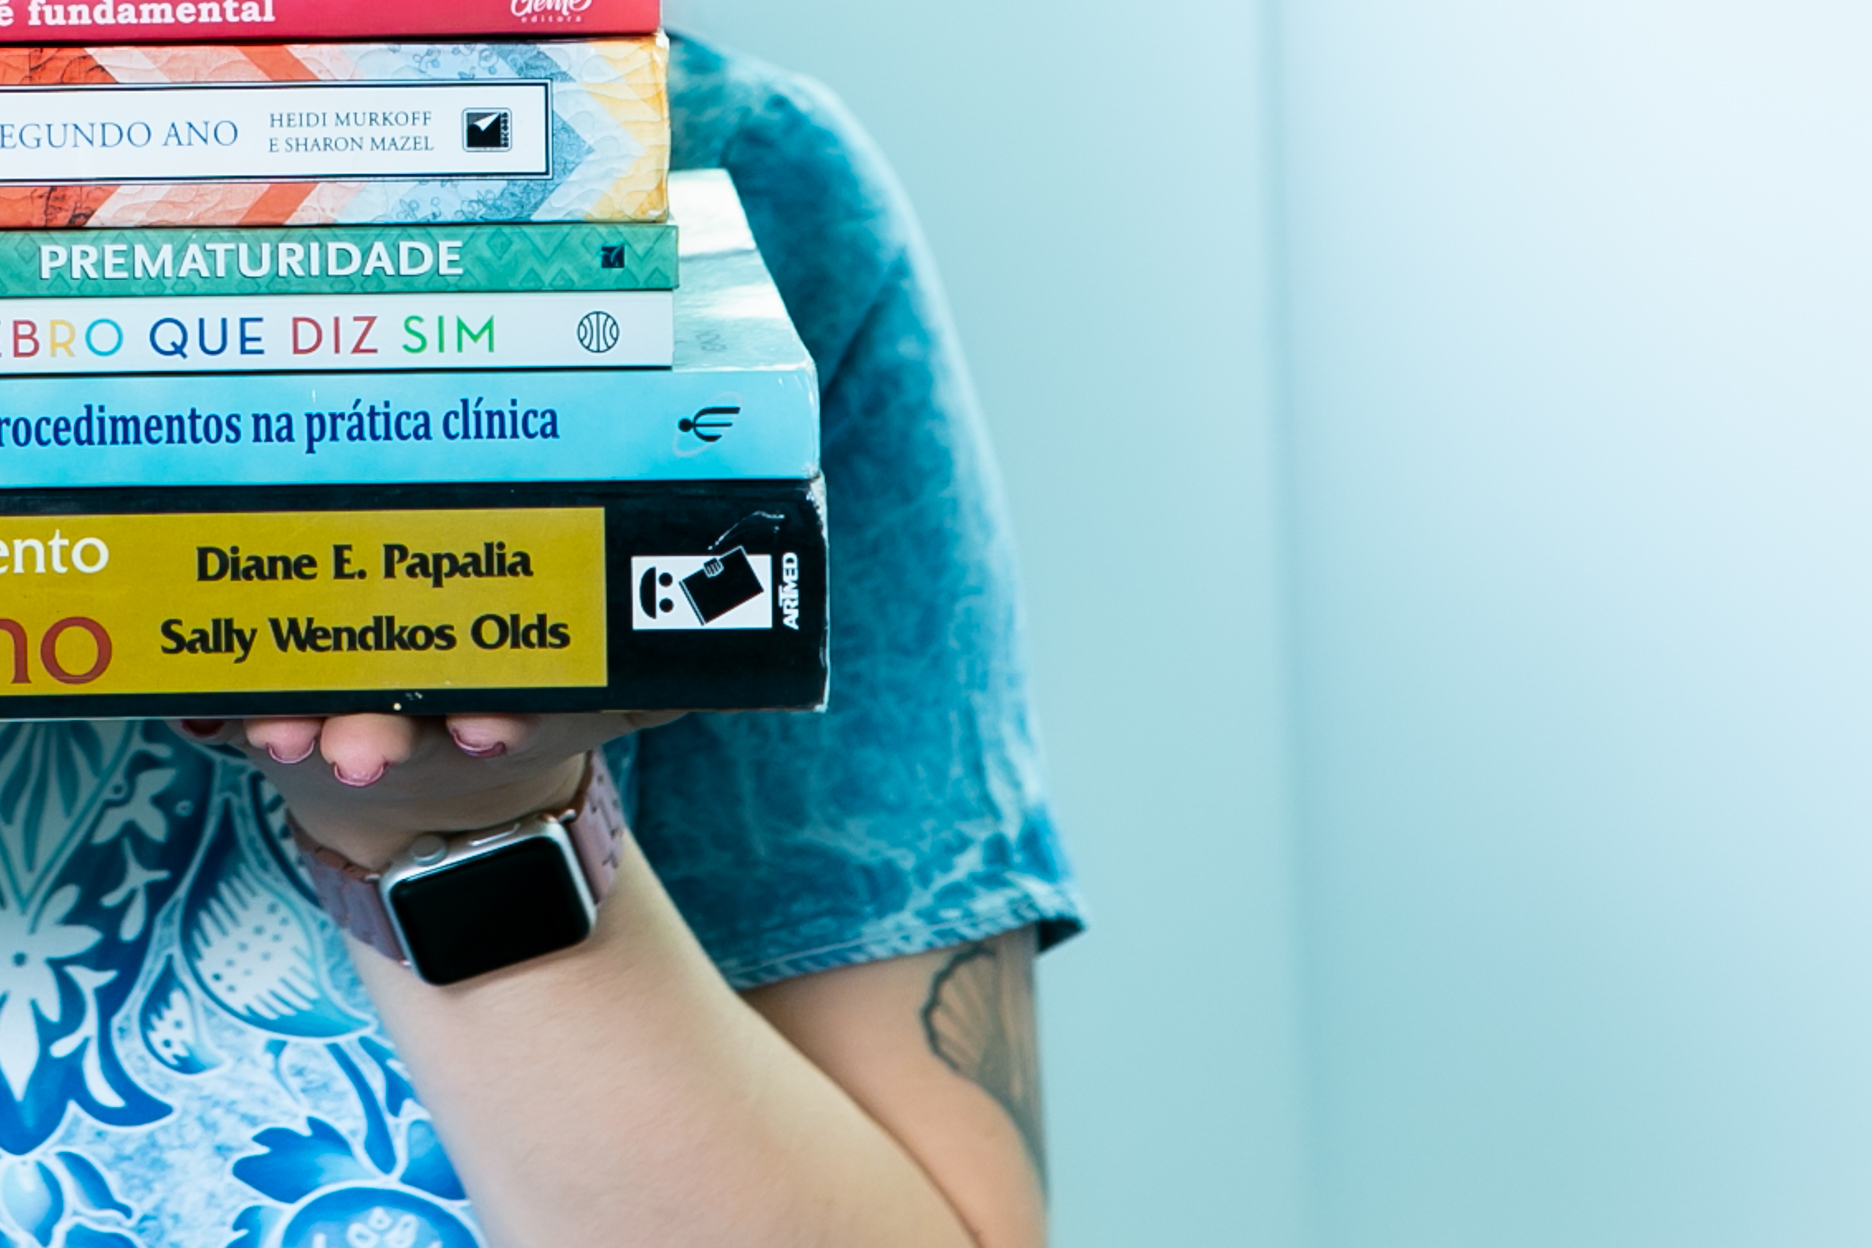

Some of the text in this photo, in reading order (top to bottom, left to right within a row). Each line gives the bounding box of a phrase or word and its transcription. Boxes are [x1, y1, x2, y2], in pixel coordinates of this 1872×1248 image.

[162, 119, 239, 148] ANO
[269, 110, 433, 129] HEIDI MURKOFF
[269, 135, 435, 153] E SHARON MAZEL
[40, 240, 464, 279] PREMATURIDADE
[149, 317, 265, 360] QUE
[292, 315, 379, 355] DIZ
[401, 314, 496, 354] SIM
[251, 412, 296, 443] na
[305, 399, 433, 454] prática
[442, 395, 561, 440] clínica
[196, 542, 534, 588] Diane E. Papalia
[778, 551, 799, 630] ARTMED
[160, 613, 571, 664] Sally Wendkos Olds
